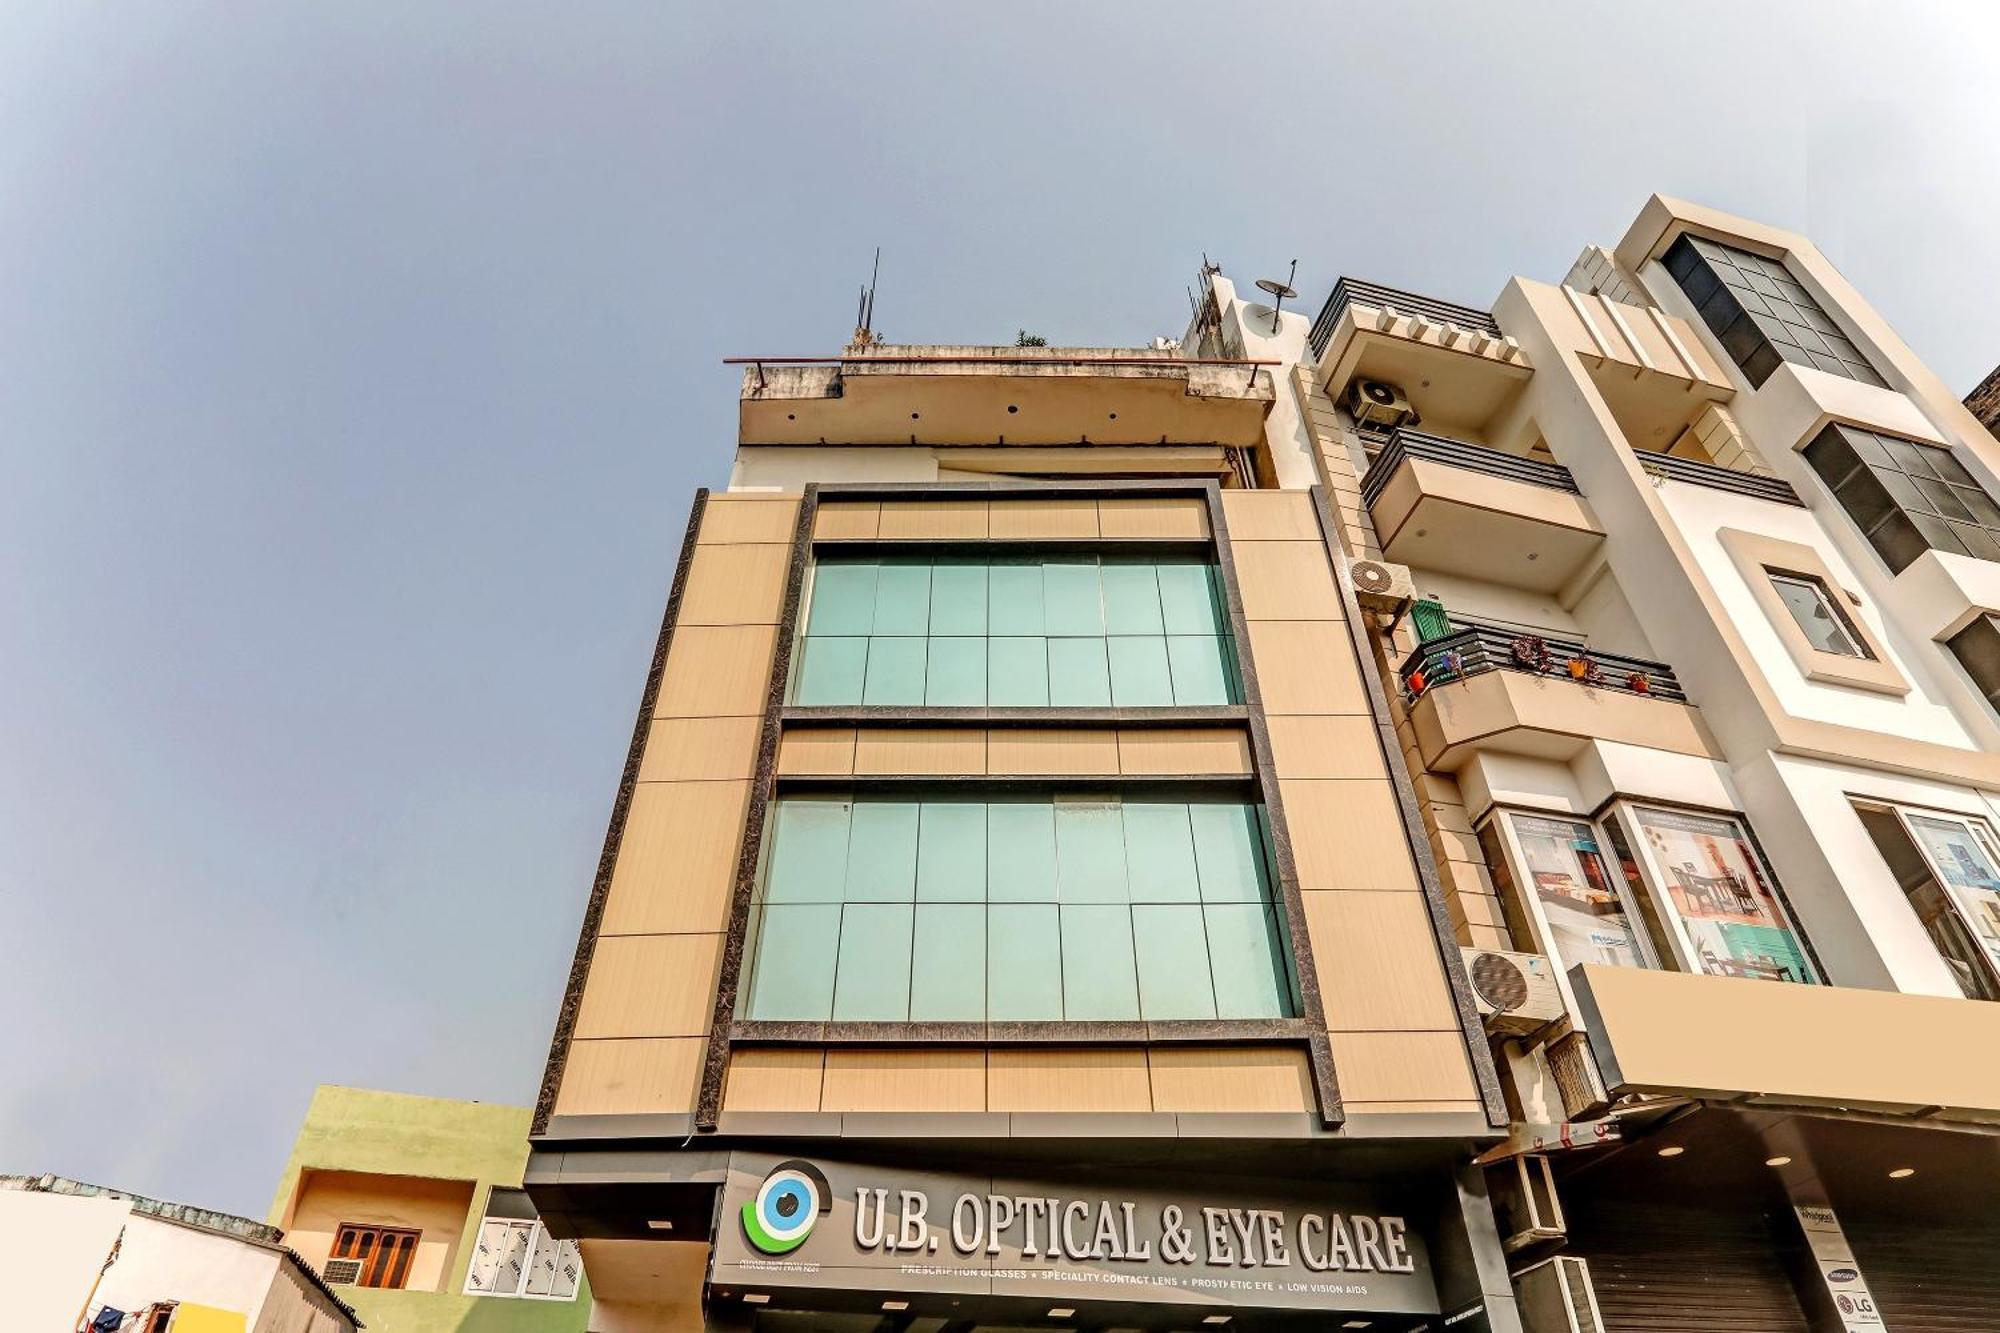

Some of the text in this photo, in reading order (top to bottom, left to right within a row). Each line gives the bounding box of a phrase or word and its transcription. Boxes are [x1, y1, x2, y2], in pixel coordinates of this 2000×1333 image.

[856, 1187, 1415, 1273] U.B. OPTICAL & EYE CARE
[901, 1264, 977, 1277] PRESCRIPTION
[981, 1267, 1026, 1279] GLASSES
[1041, 1270, 1099, 1283] SPECIALITY
[1103, 1273, 1149, 1285] CONTACT
[1152, 1276, 1178, 1287] LENS
[1255, 1281, 1274, 1292] EYE
[1287, 1283, 1308, 1293] LOW
[1311, 1284, 1343, 1295] VISION
[1346, 1286, 1368, 1296] AIDS
[1853, 1298, 1873, 1313] LG
